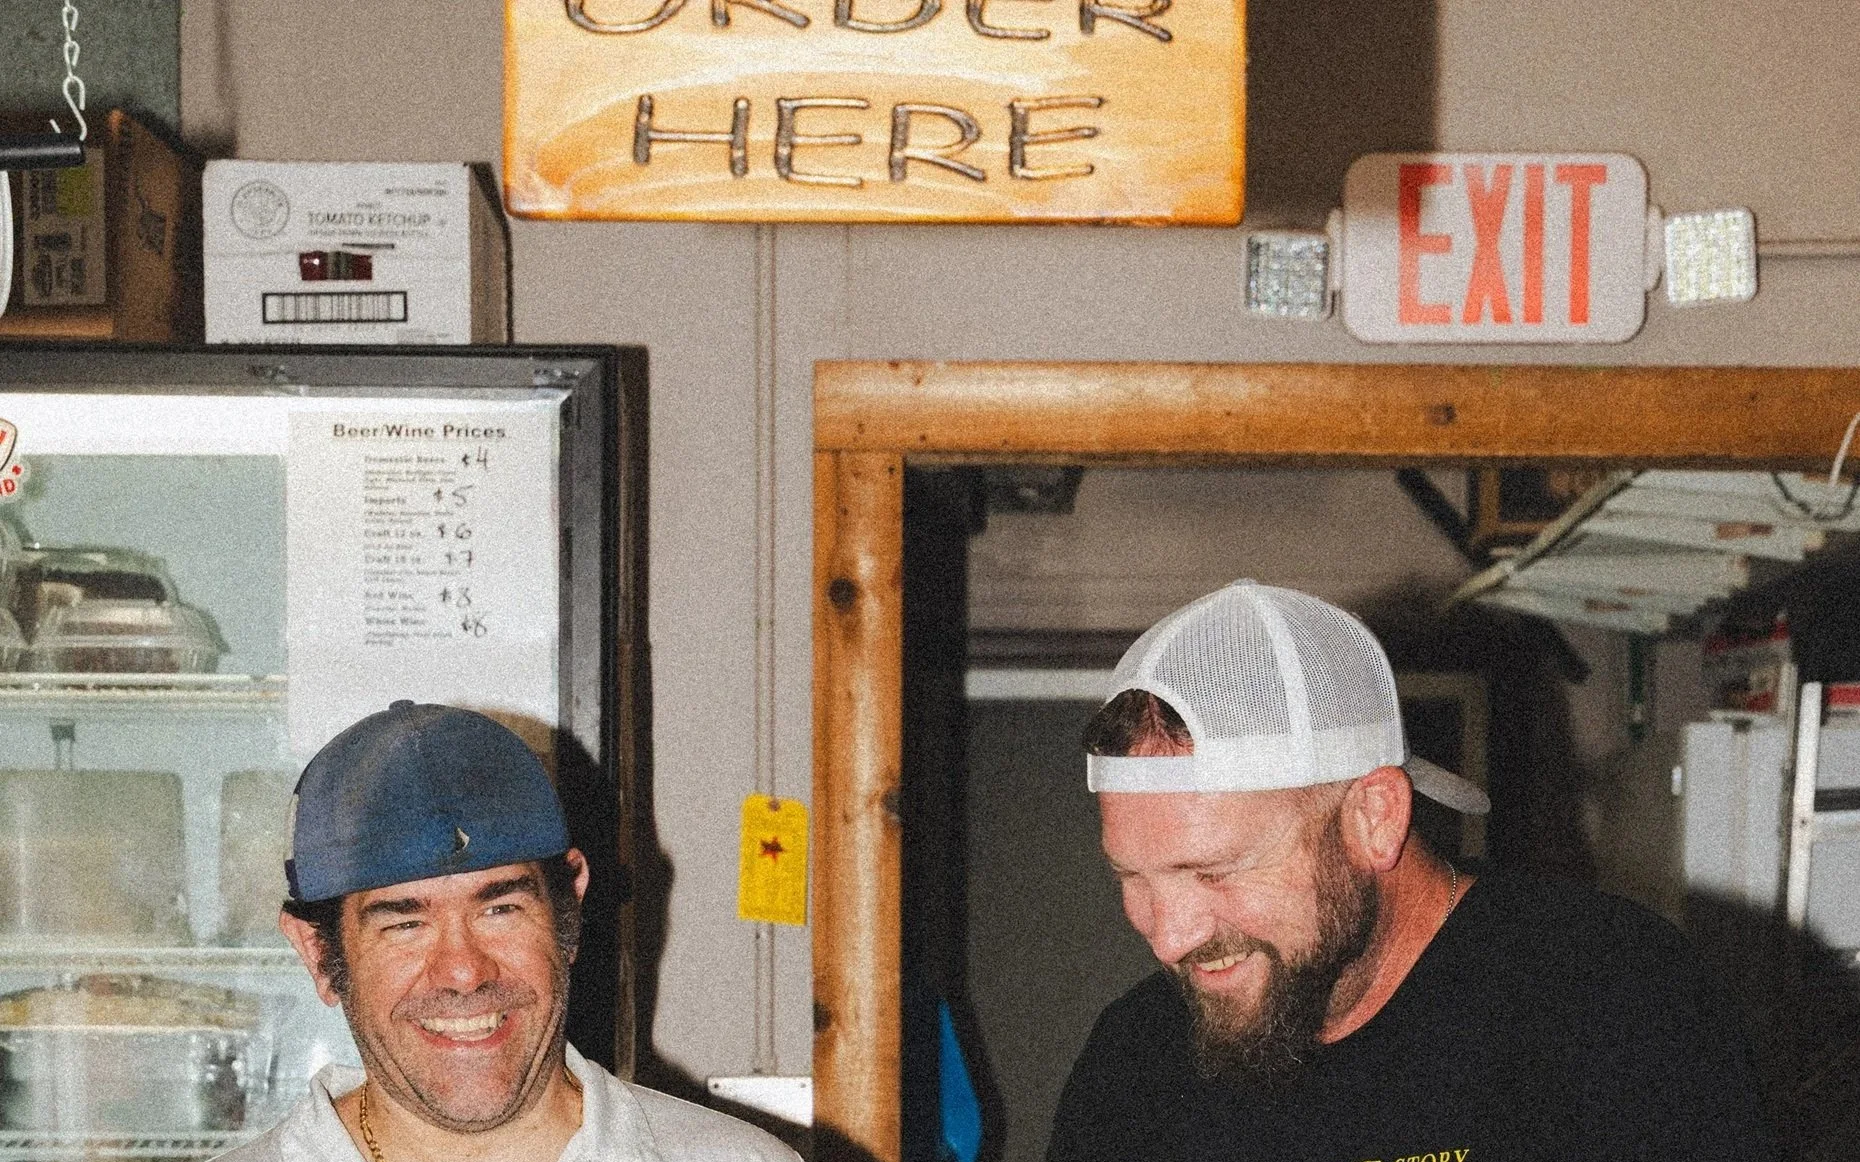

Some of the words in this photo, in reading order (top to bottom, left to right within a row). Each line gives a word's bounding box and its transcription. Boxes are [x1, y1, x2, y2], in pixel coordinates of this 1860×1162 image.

[634, 94, 1105, 188] HERE
[307, 212, 364, 227] TOMATO
[368, 212, 432, 227] KETCHUP
[1397, 163, 1608, 326] EXIT
[443, 424, 506, 439] Prices
